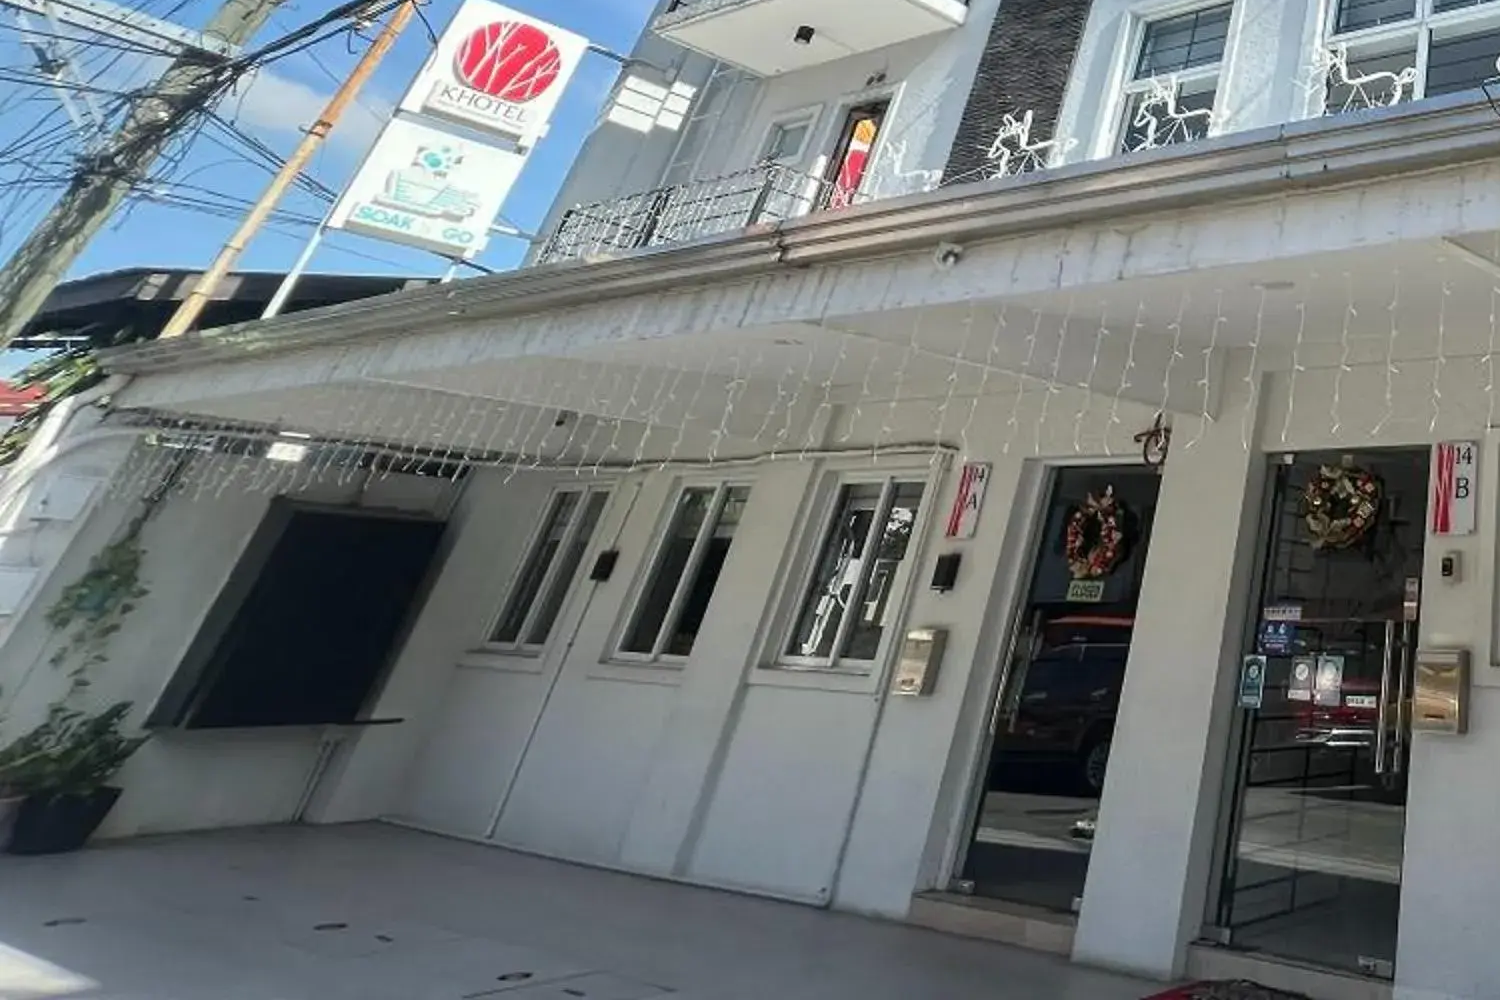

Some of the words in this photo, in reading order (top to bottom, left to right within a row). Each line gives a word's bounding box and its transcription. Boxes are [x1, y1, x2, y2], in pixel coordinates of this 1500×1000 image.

[441, 84, 527, 123] KHOTEL
[355, 206, 413, 230] SOAK
[442, 228, 474, 243] GO
[1455, 447, 1472, 464] 14
[1455, 478, 1469, 498] B
[965, 493, 977, 509] A
